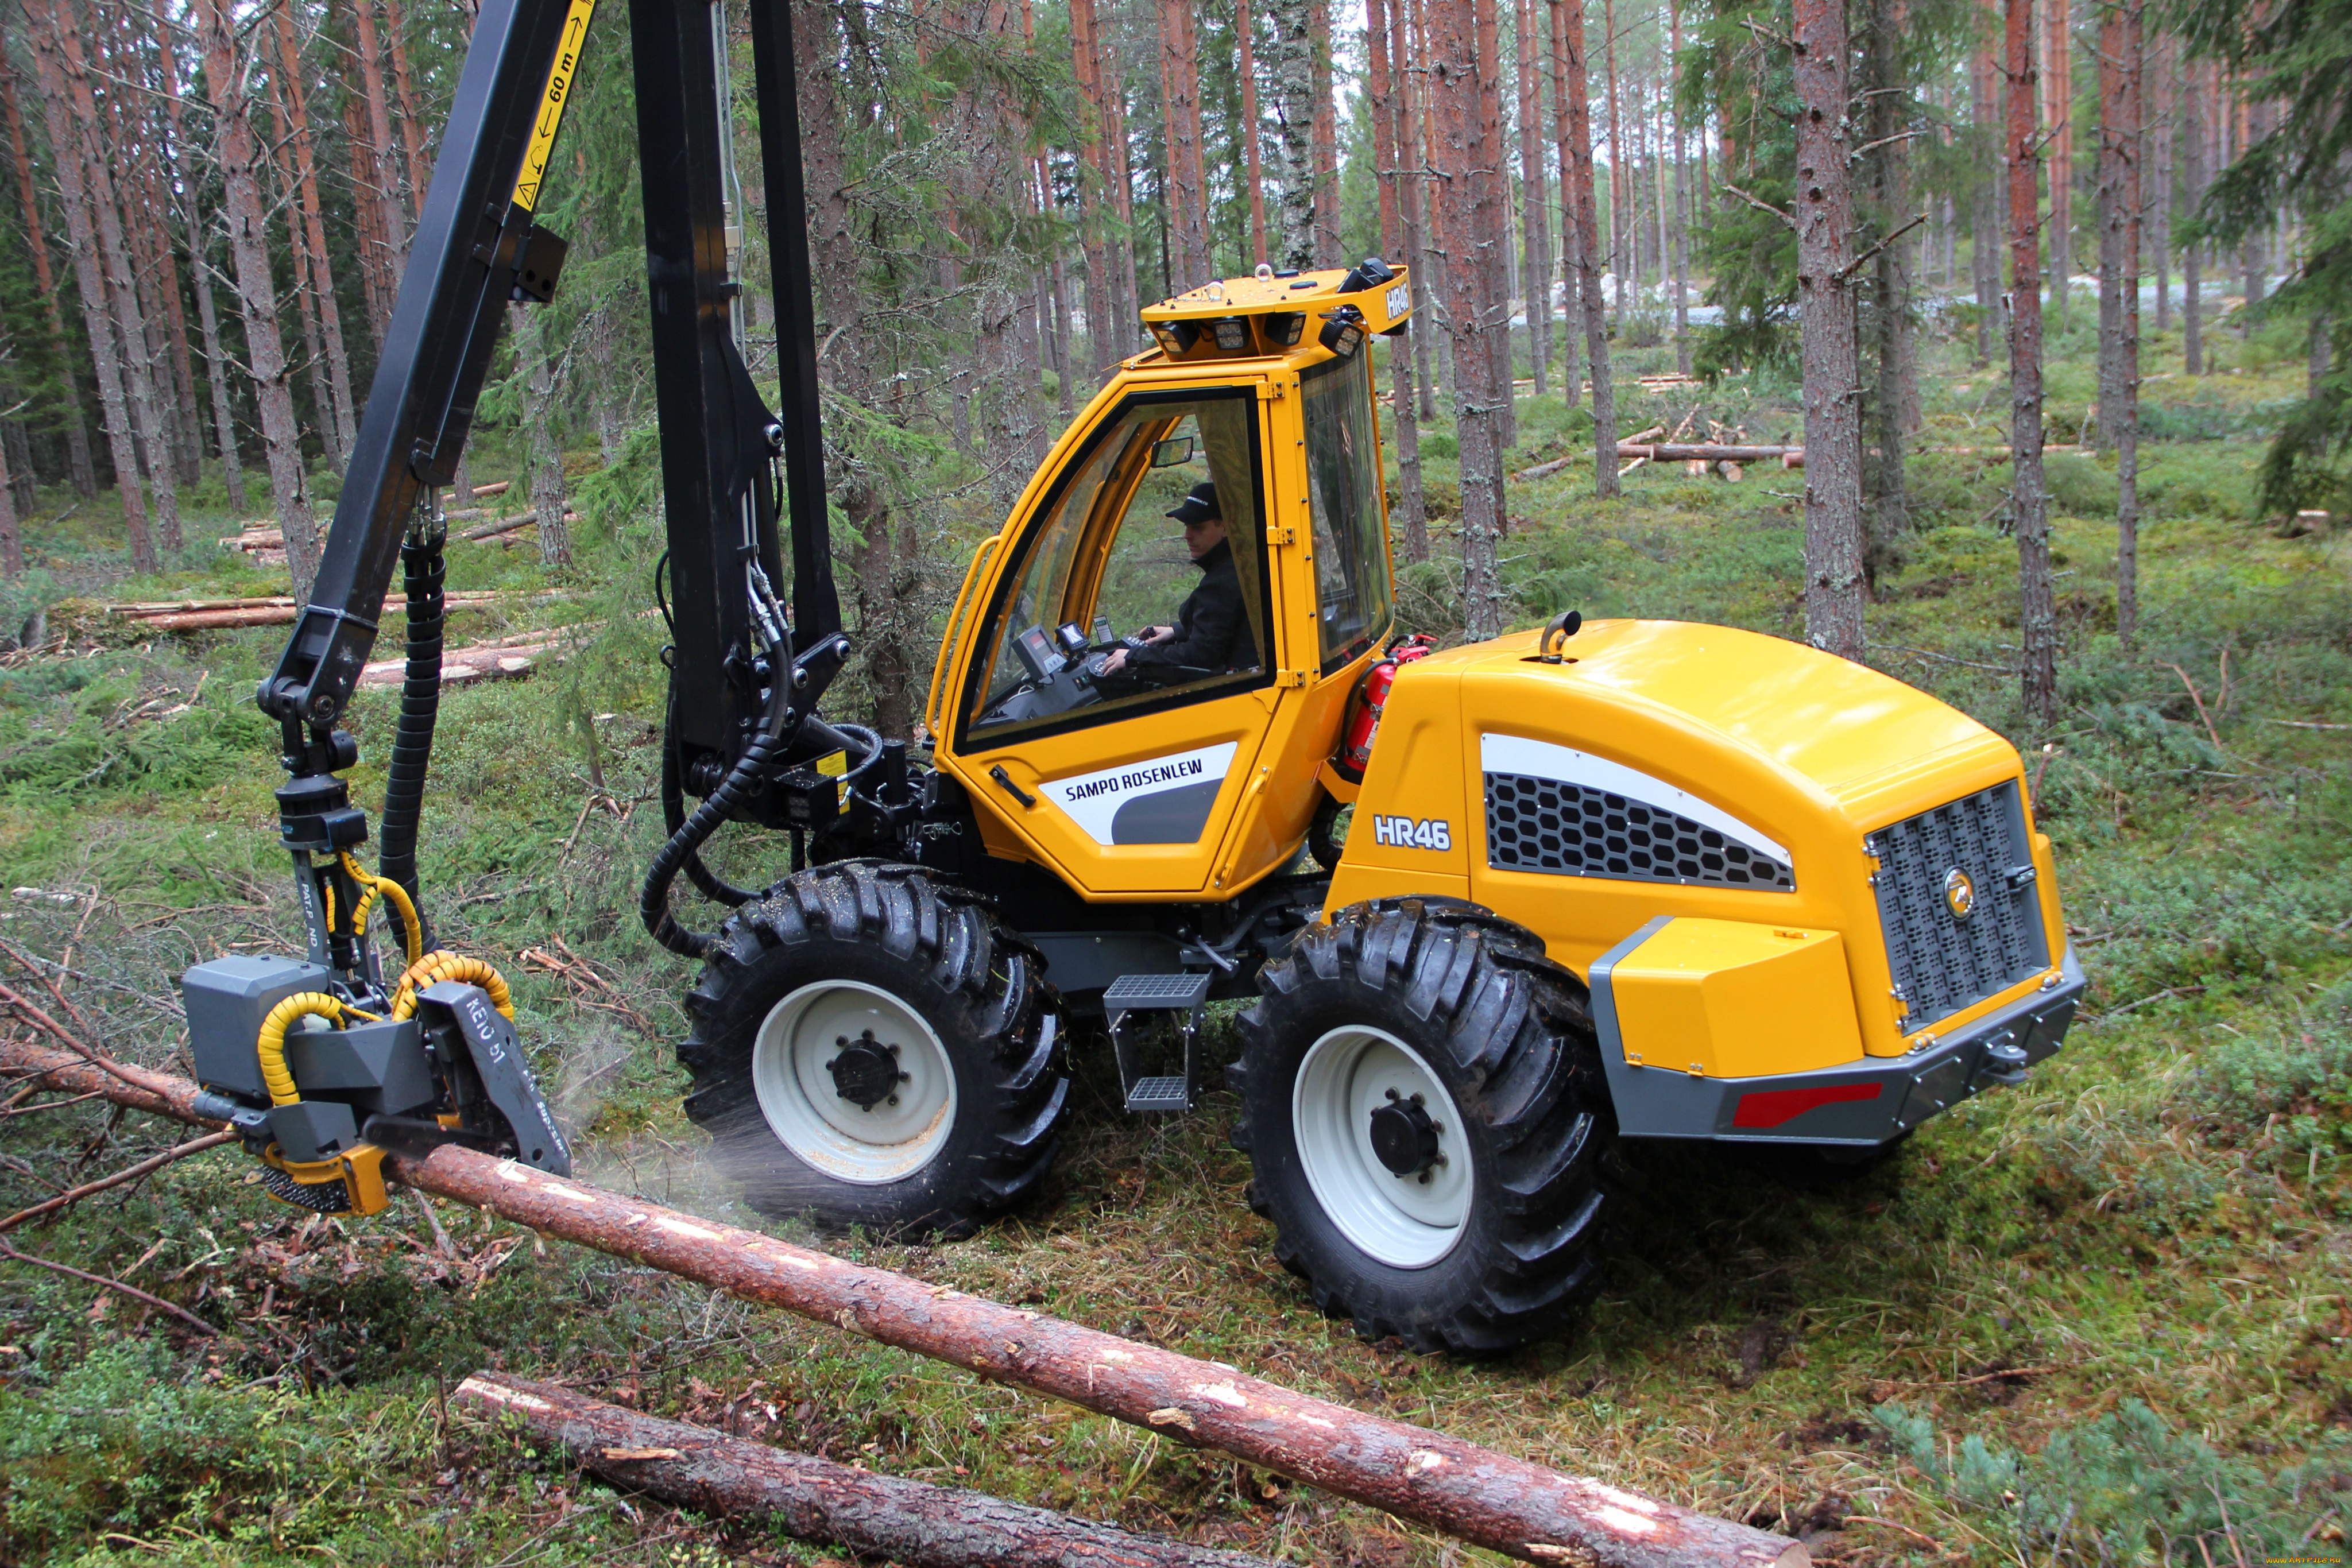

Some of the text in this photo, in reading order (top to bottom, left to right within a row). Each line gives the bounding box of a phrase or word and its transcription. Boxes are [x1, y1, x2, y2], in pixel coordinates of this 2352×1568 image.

[550, 53, 573, 103] 60 m
[1386, 281, 1409, 321] HR46
[1065, 758, 1203, 802] SAMPO ROSENLEW
[1373, 814, 1451, 851] HR46
[466, 997, 496, 1040] KETO
